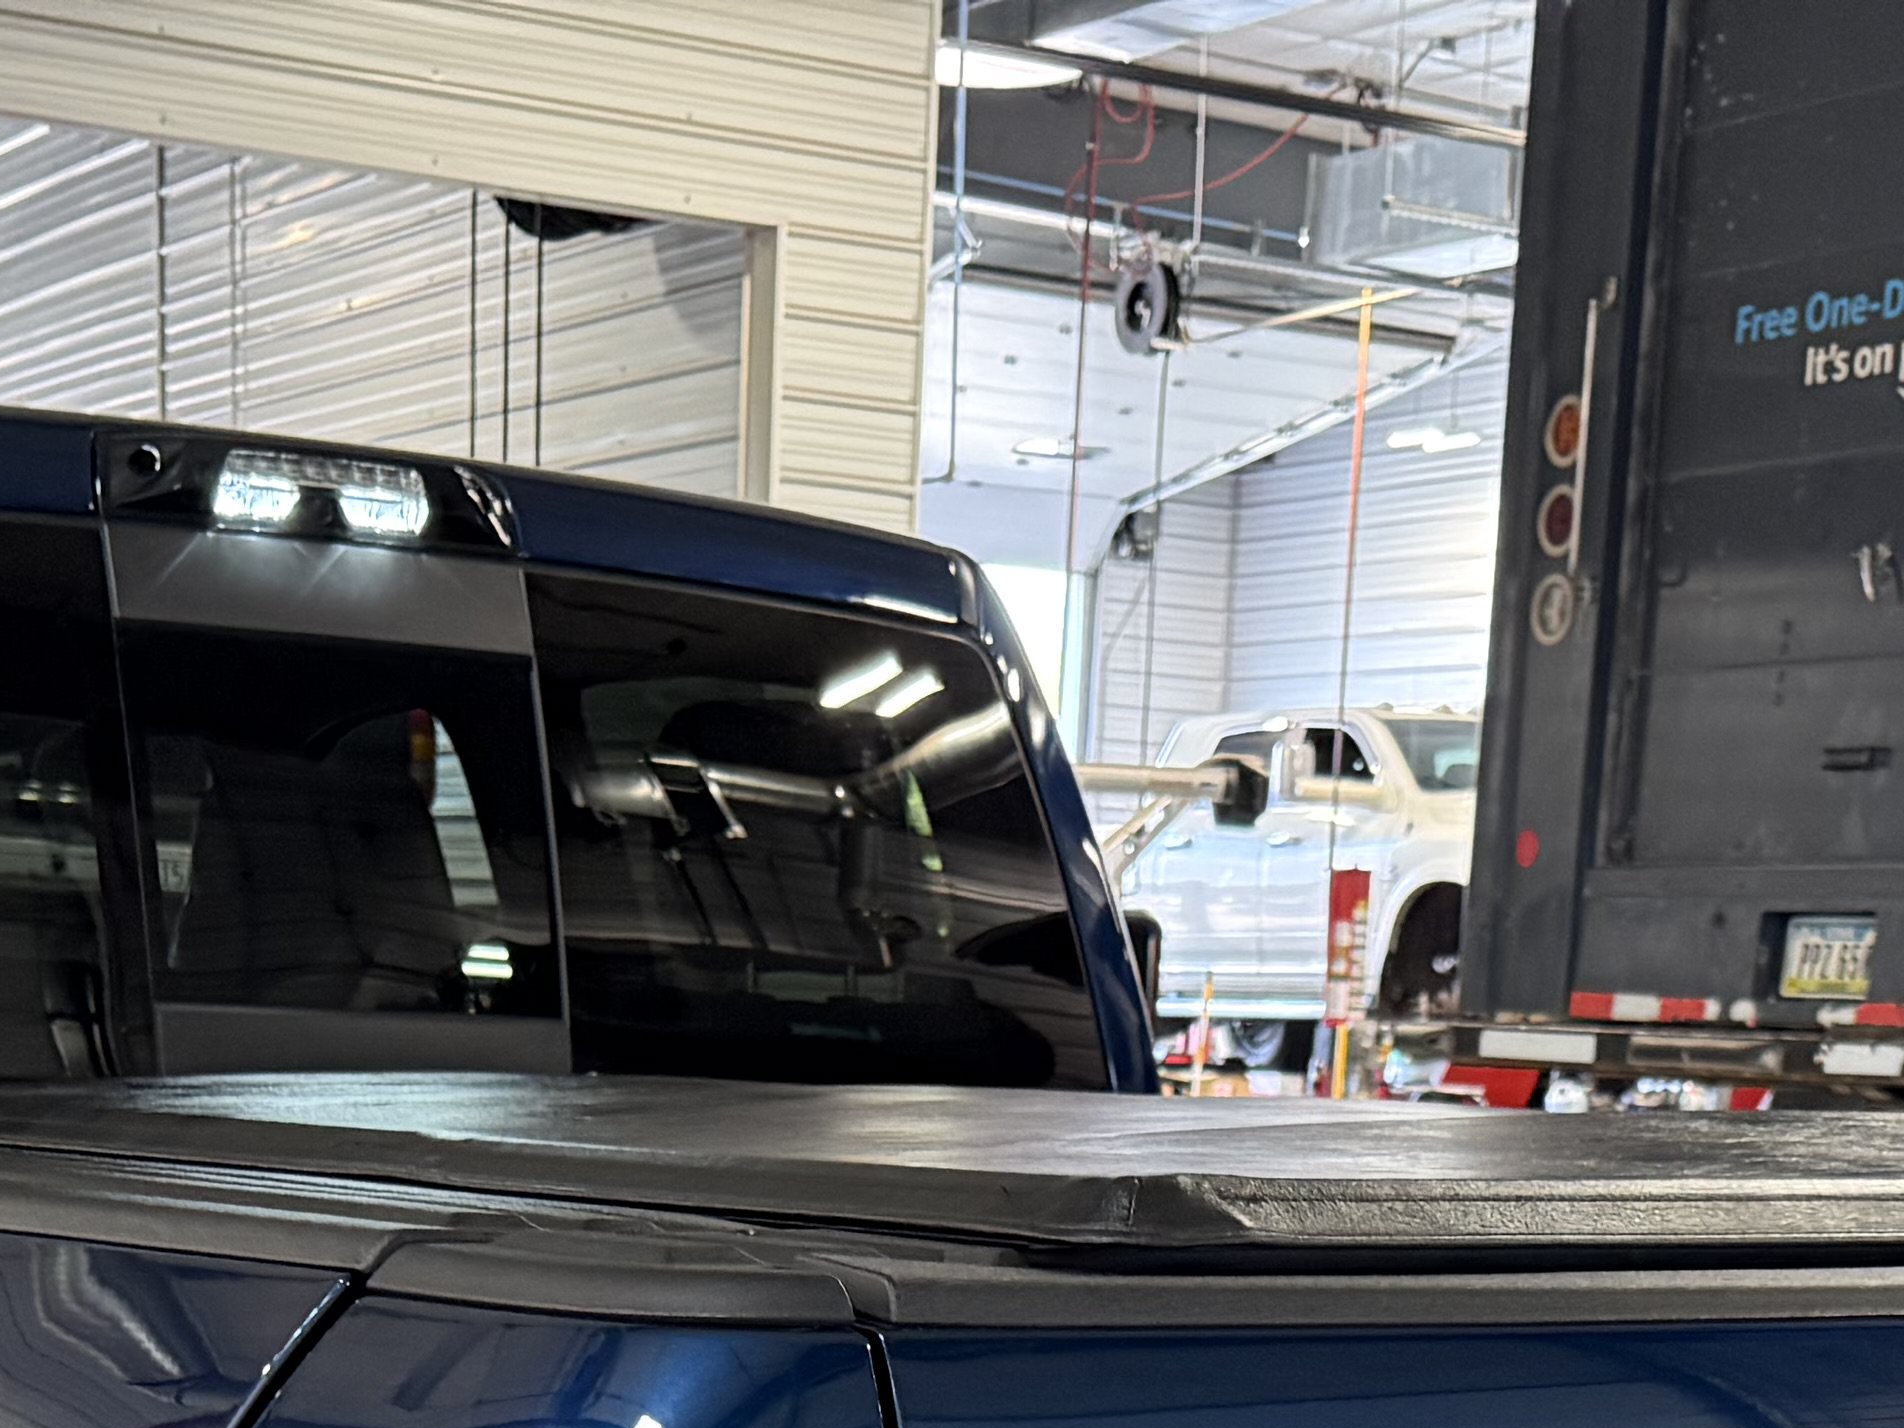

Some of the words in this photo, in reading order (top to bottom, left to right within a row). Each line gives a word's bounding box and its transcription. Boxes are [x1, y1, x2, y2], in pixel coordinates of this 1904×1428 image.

[1734, 304, 1798, 344] Free
[1803, 342, 1850, 386] It's
[1853, 343, 1895, 379] on
